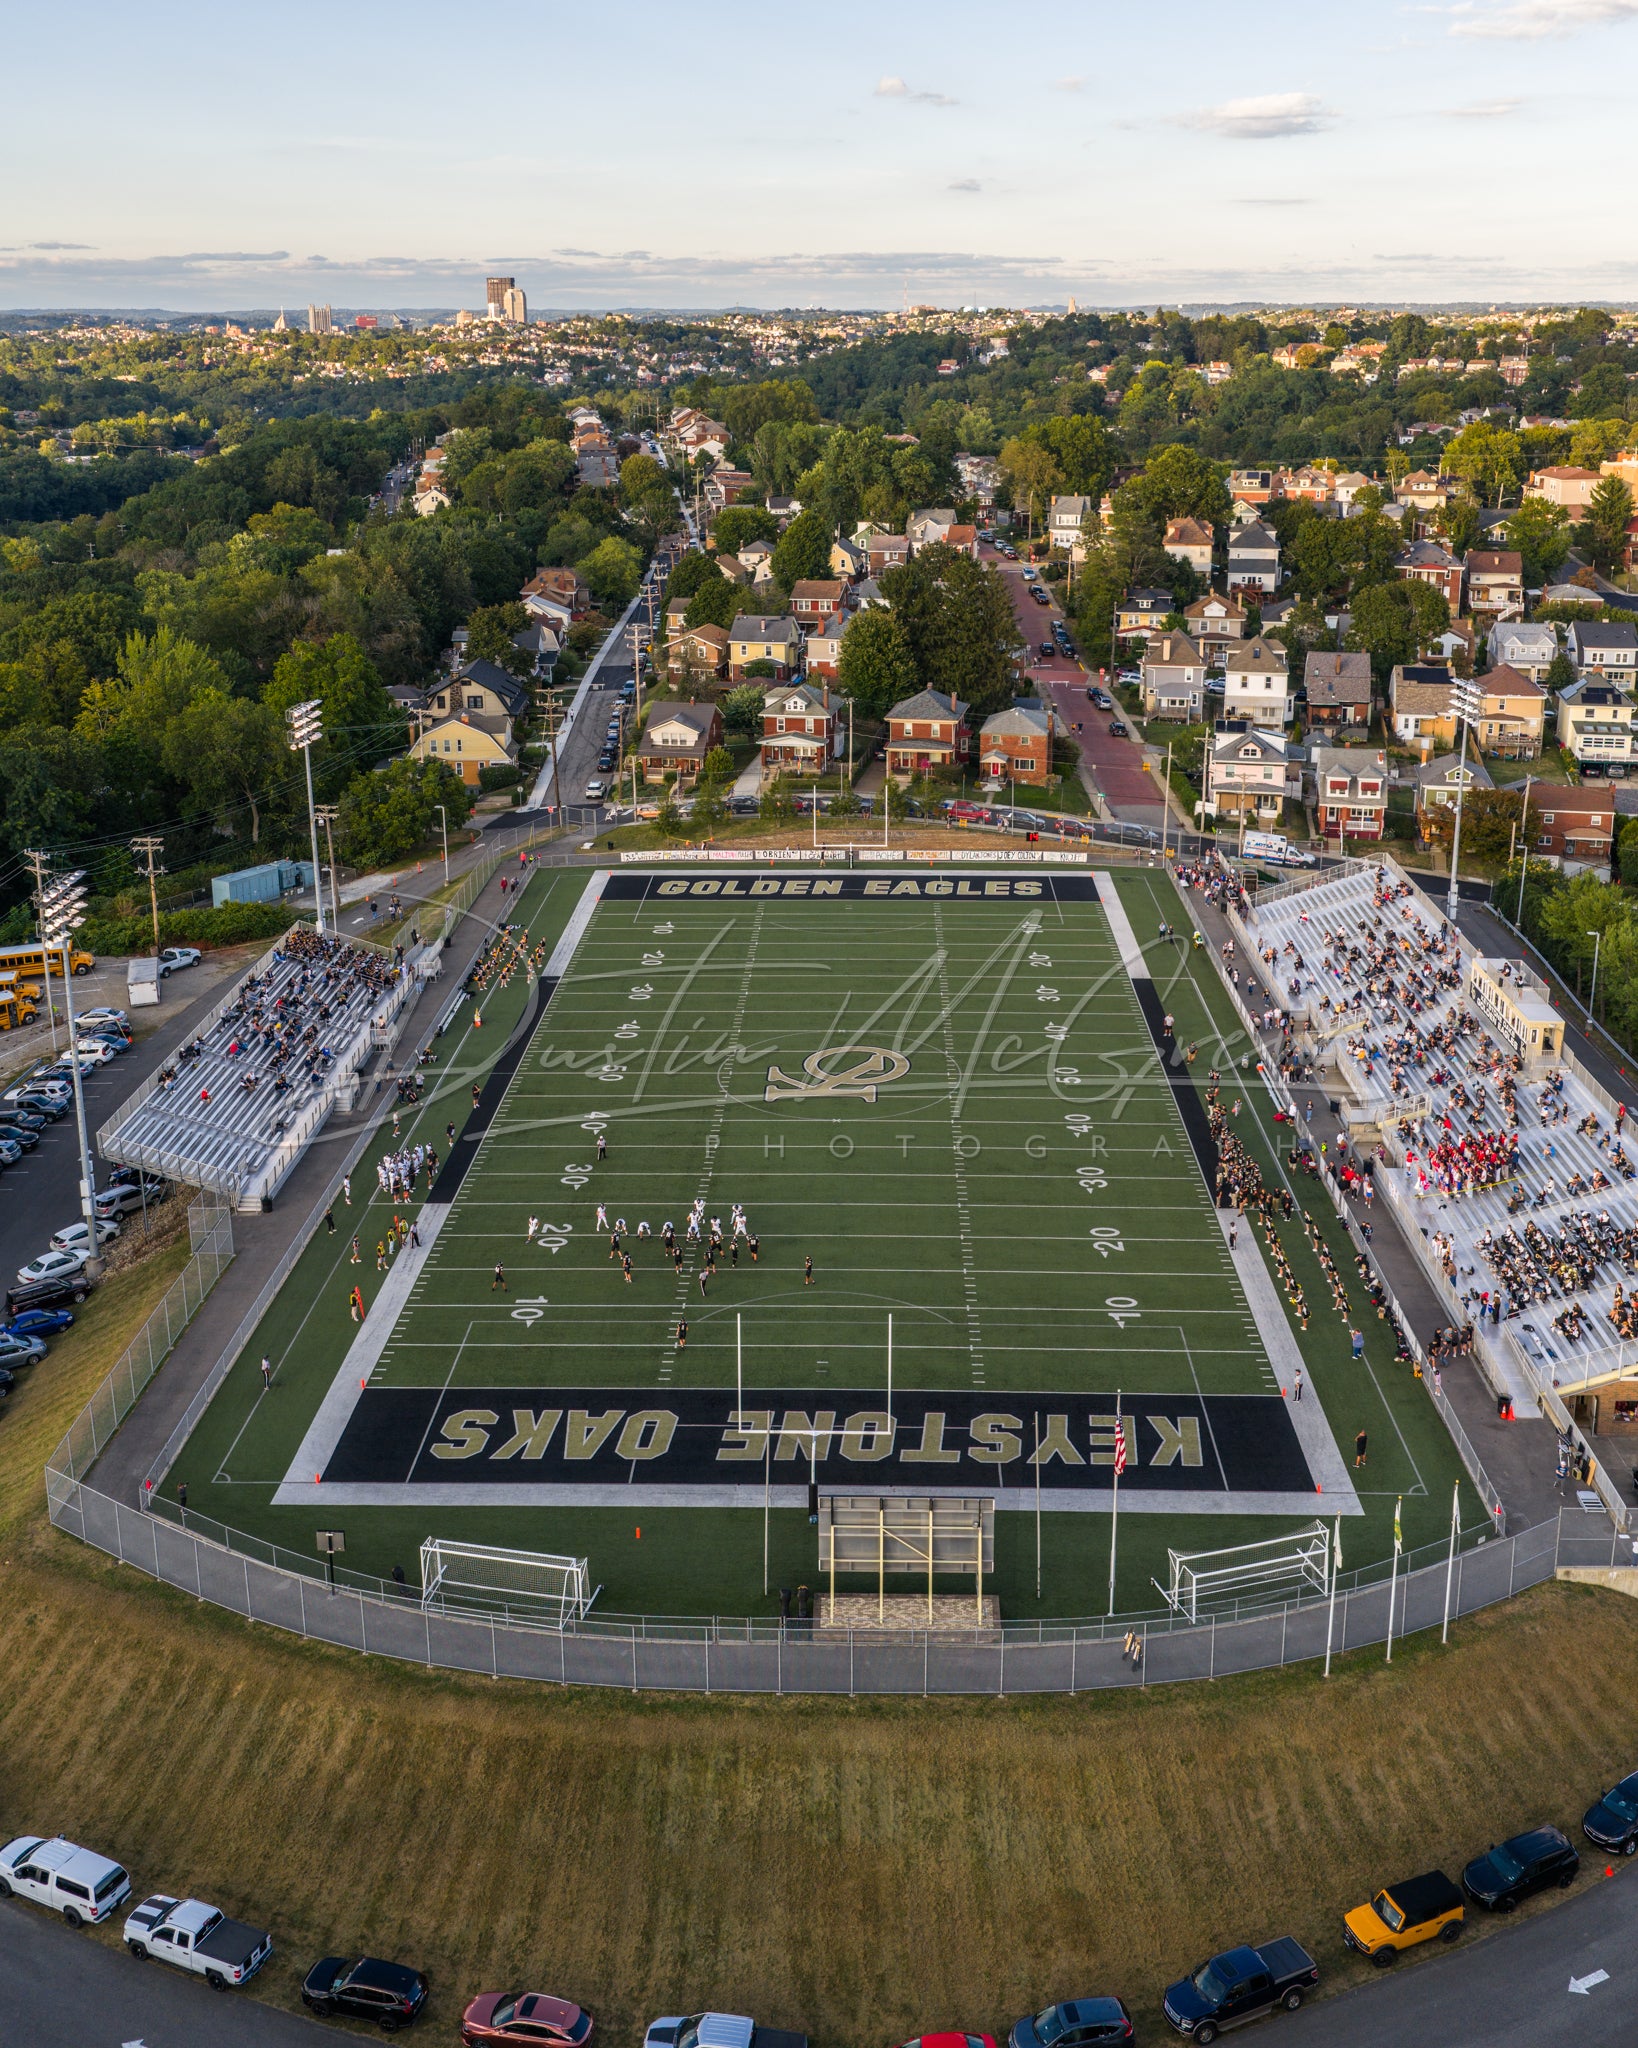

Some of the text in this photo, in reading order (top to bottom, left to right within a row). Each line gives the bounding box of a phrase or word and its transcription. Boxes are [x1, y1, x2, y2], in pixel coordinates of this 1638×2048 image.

[656, 879, 1043, 896] GOLDEN EAGLES
[652, 922, 675, 935] 10
[1021, 923, 1044, 935] 10
[641, 952, 665, 966] 20
[1028, 954, 1053, 968] 20
[628, 986, 653, 1000] 30
[1035, 987, 1060, 1002] 30
[614, 1023, 641, 1039] 40
[1044, 1025, 1070, 1041] 40
[598, 1064, 628, 1081] 50
[1053, 1066, 1082, 1084] 50
[580, 1111, 611, 1130] 40
[1064, 1113, 1094, 1133] 40
[560, 1163, 594, 1185] 30
[1076, 1166, 1108, 1189] 30
[537, 1223, 573, 1247] 20
[1089, 1227, 1125, 1252] 20
[510, 1295, 549, 1320] 10
[1105, 1297, 1142, 1321] 10
[429, 1409, 1204, 1467] KEYSTONE OAKS
